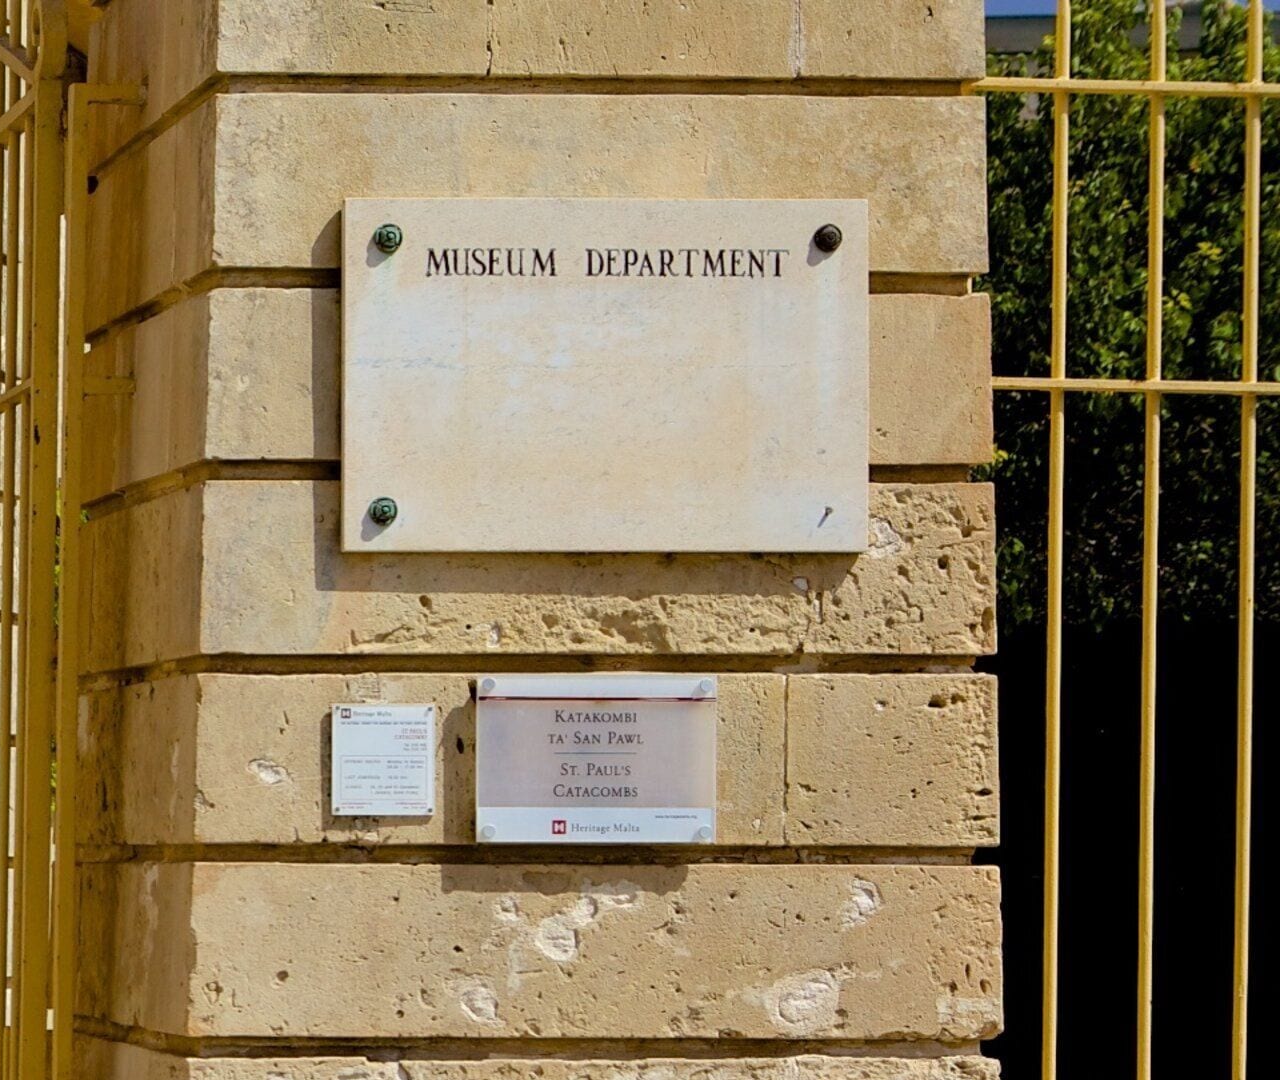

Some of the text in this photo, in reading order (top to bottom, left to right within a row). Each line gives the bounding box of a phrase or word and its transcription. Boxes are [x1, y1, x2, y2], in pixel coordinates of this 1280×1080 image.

[425, 247, 790, 279] MUSEUM DEPARTMENT
[554, 709, 638, 723] KATAKOMBI
[573, 731, 601, 745] SAN
[607, 731, 644, 745] PAWL
[560, 762, 632, 776] ST. PAUL'S
[552, 784, 639, 798] CATACOMBS
[571, 823, 640, 834] Heritage Malta
